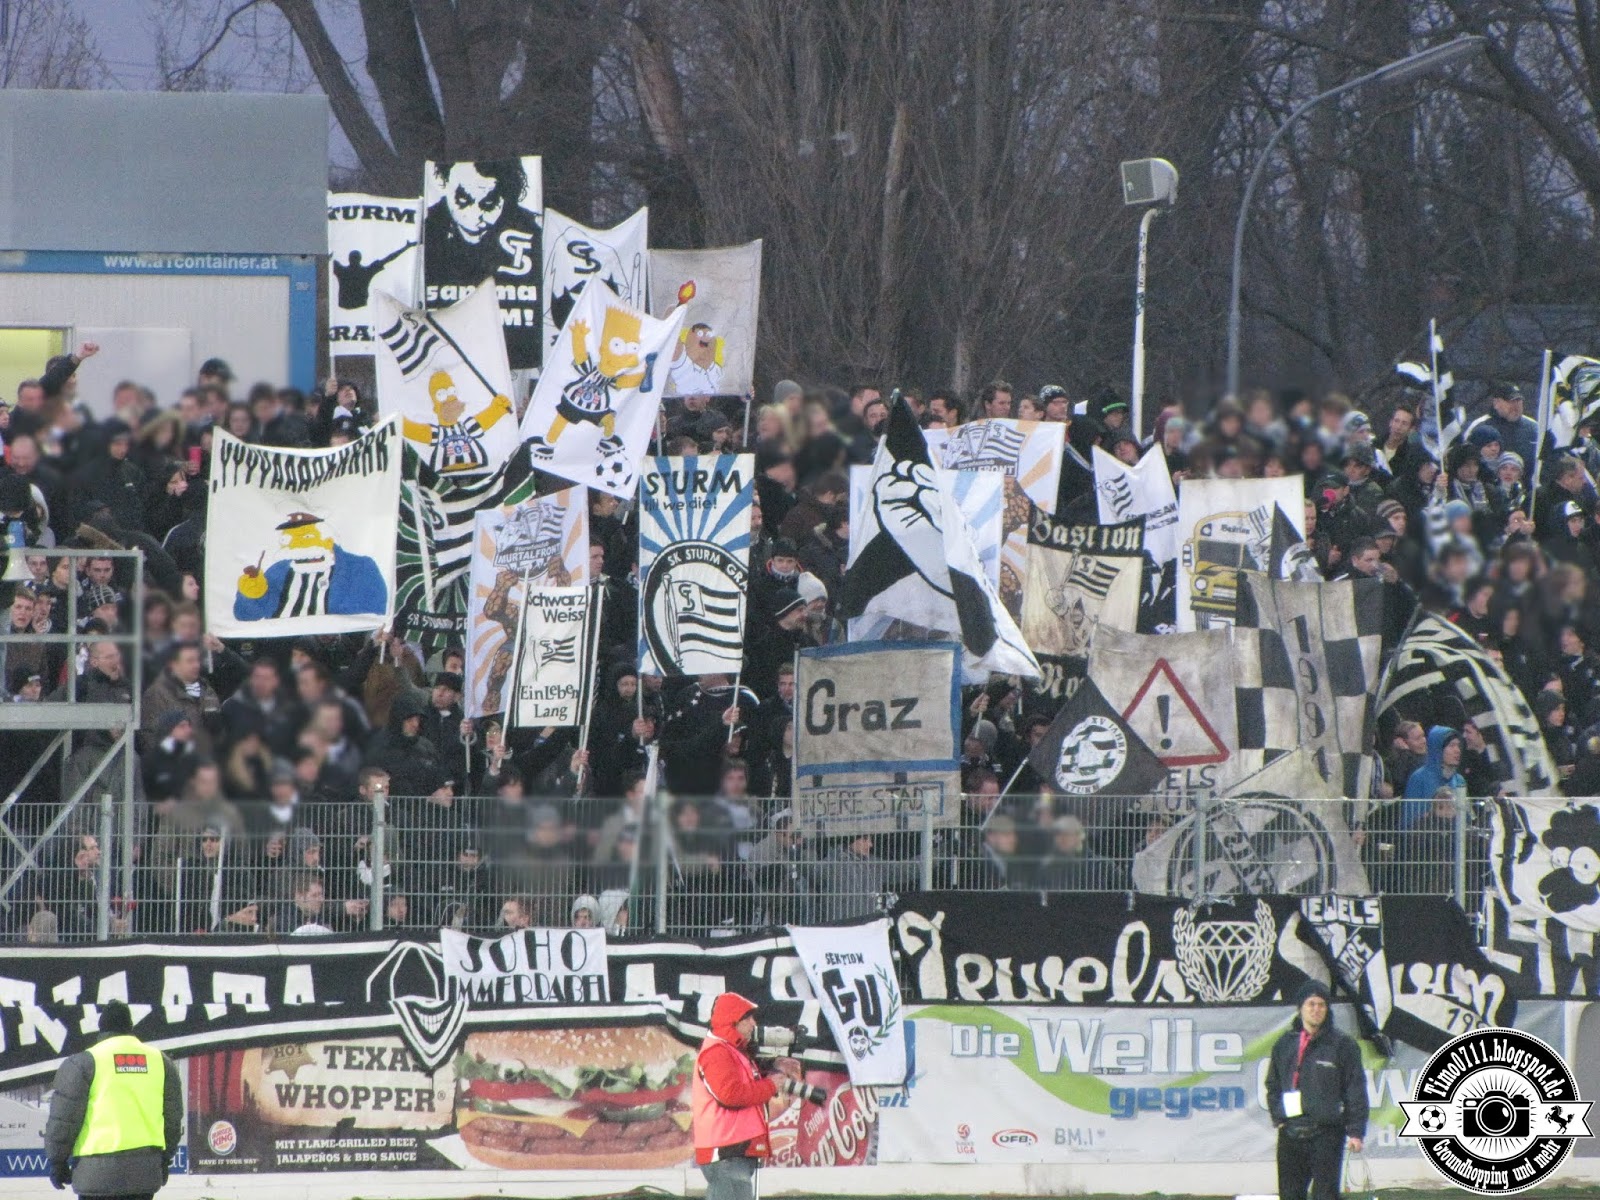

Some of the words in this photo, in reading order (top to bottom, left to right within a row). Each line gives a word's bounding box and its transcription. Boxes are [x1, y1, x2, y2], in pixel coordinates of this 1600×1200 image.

[328, 205, 416, 224] TURM
[646, 470, 742, 496] STURM
[664, 501, 684, 511] we
[691, 496, 717, 509] die!
[667, 553, 682, 566] SK
[685, 550, 720, 565] STURM
[726, 564, 749, 592] GRA
[543, 608, 585, 623] Weiss
[533, 704, 568, 721] Lang
[805, 678, 921, 736] Graz
[460, 930, 587, 973] SOHO
[898, 910, 1195, 1002] Jewels
[822, 968, 883, 1027] GU
[323, 1045, 419, 1073] TEXA
[951, 1023, 1020, 1057] Die
[1028, 1017, 1244, 1075] Welle
[1109, 1086, 1245, 1119] gegen
[275, 1140, 295, 1150] MIT
[298, 1138, 386, 1149] FLAME-GRILLED
[390, 1138, 418, 1149] BEEF,
[343, 1153, 351, 1162] &
[355, 1152, 378, 1162] BBQ
[380, 1152, 417, 1162] SAUCE
